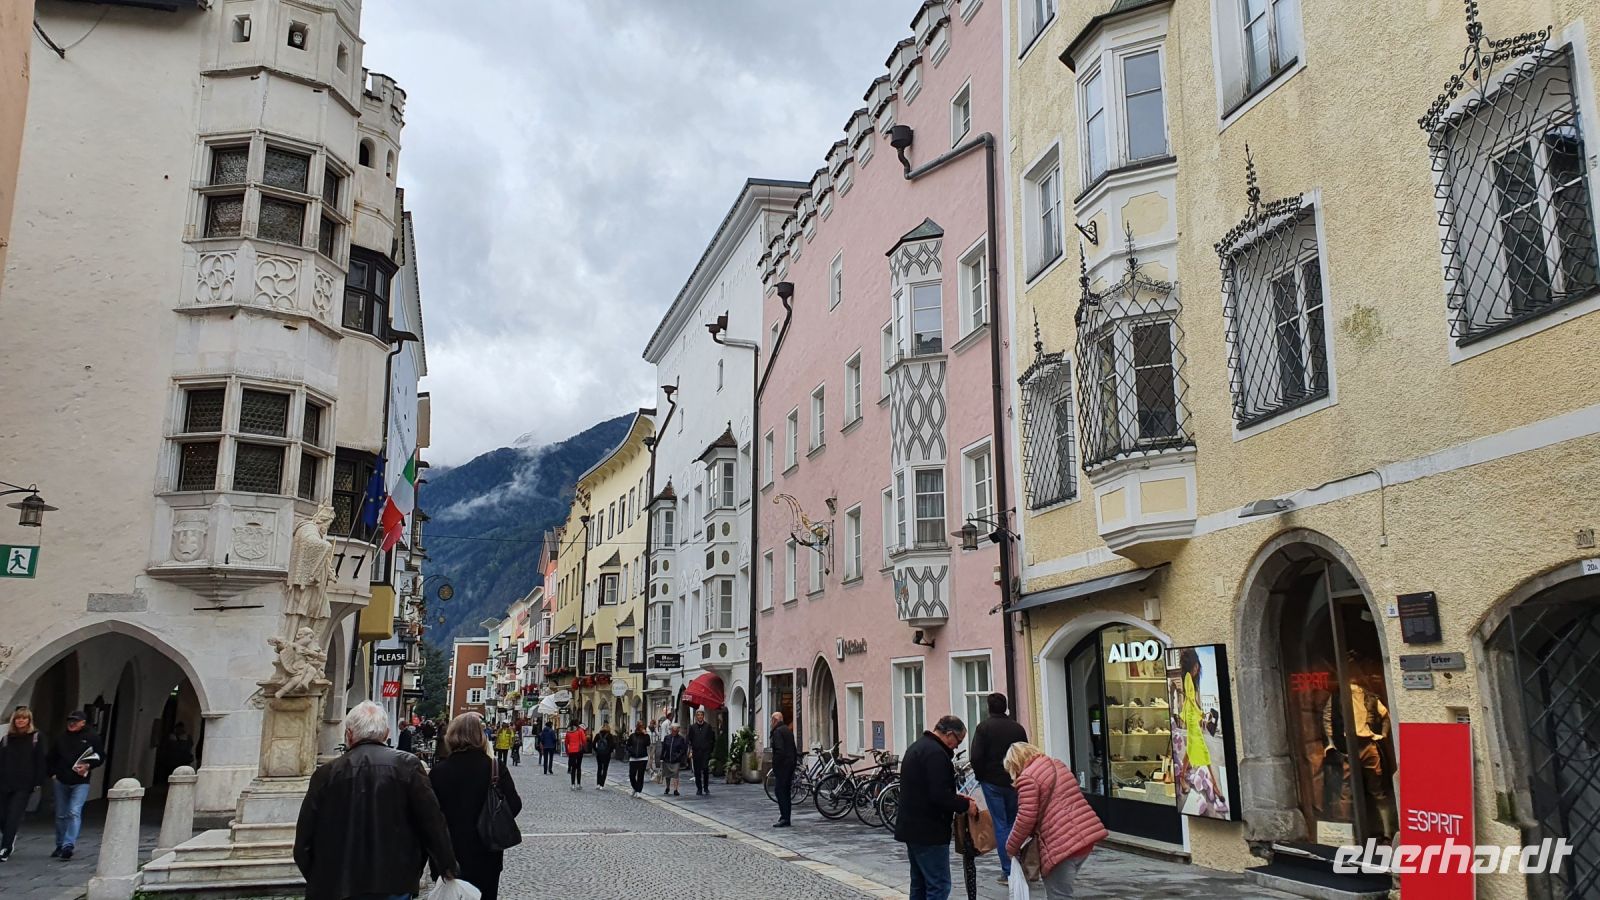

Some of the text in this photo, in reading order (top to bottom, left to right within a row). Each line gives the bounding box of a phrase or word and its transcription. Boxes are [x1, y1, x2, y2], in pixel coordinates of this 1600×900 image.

[377, 653, 406, 661] PLEASE
[1108, 640, 1159, 663] ALDO
[1431, 656, 1451, 664] Erker
[383, 683, 398, 696] illy
[1407, 809, 1464, 836] ESPRIT
